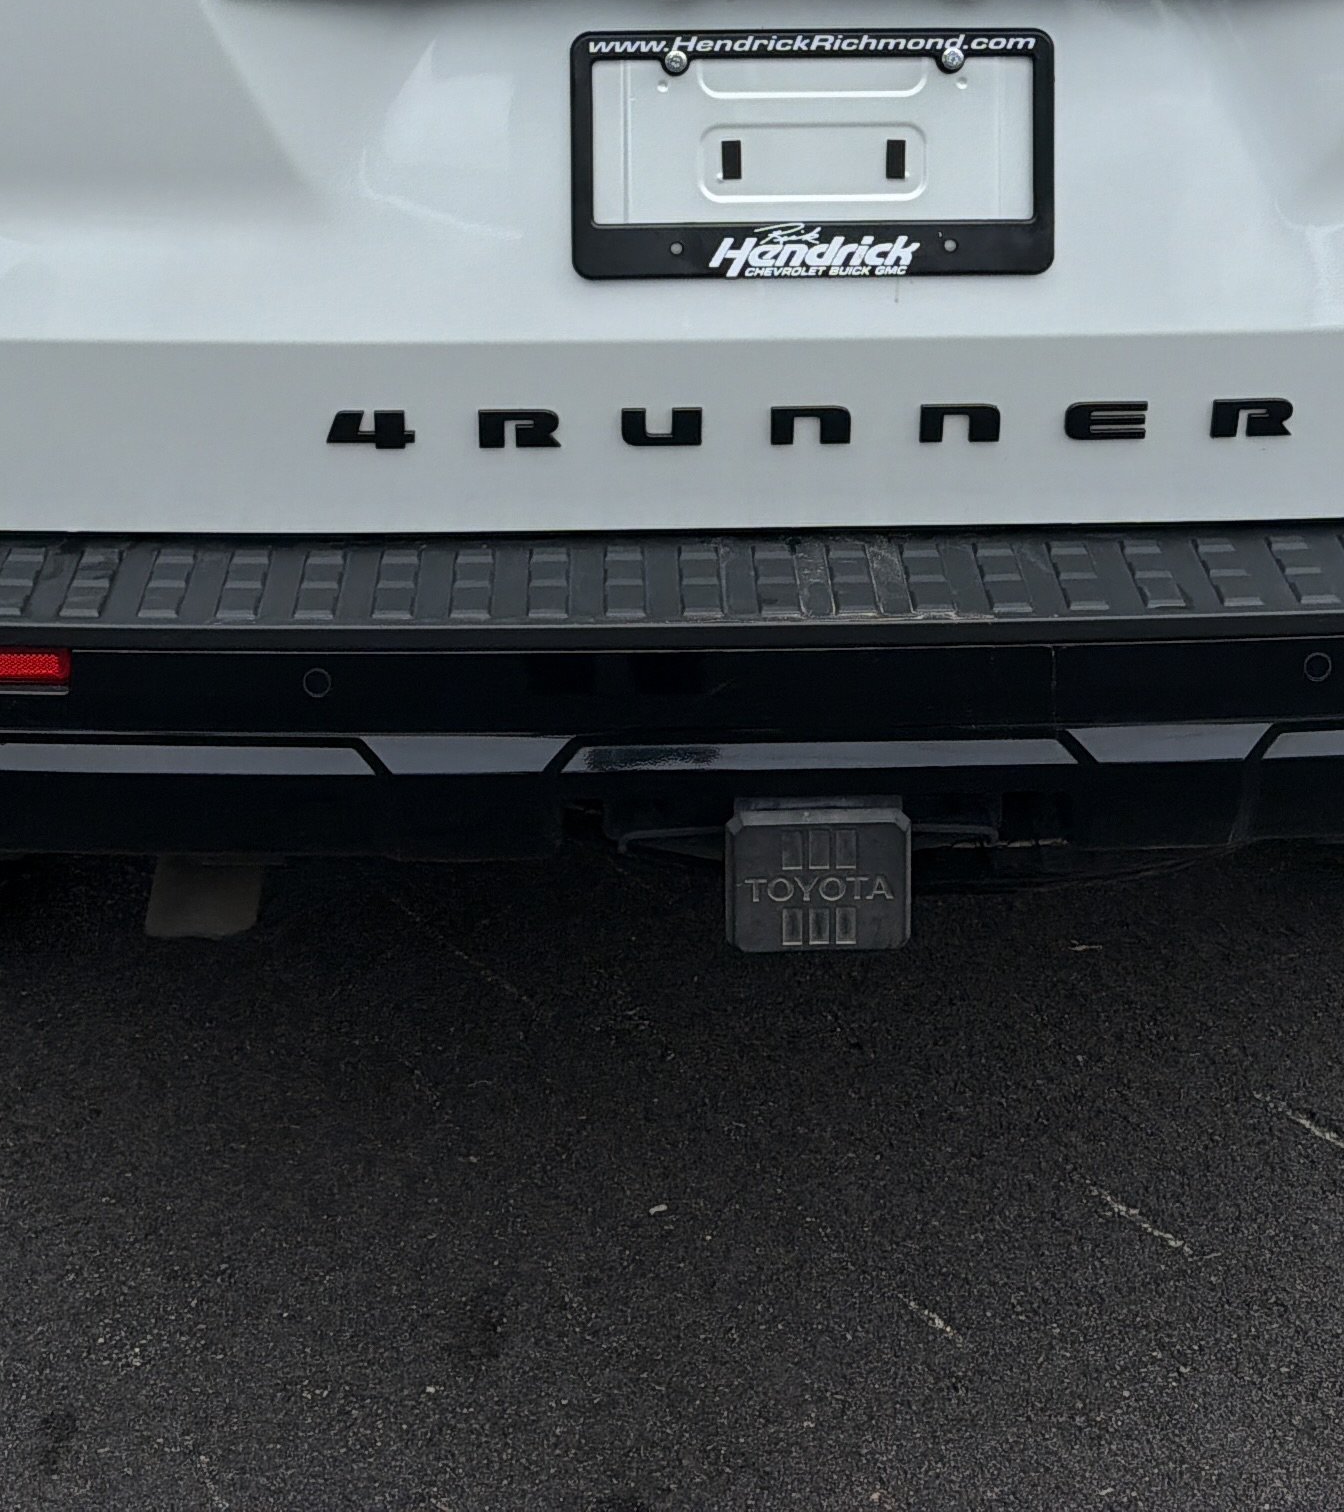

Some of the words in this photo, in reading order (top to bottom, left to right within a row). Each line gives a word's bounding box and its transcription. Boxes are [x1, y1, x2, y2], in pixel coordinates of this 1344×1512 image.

[588, 34, 1036, 53] www.HendrickRichmond.com
[709, 236, 920, 277] Hendrick
[745, 266, 826, 276] CHEVROLET
[829, 266, 872, 276] BUICK
[874, 266, 908, 275] GMC
[327, 398, 1293, 449] 4RUNNER
[745, 876, 894, 902] TOYOTA
